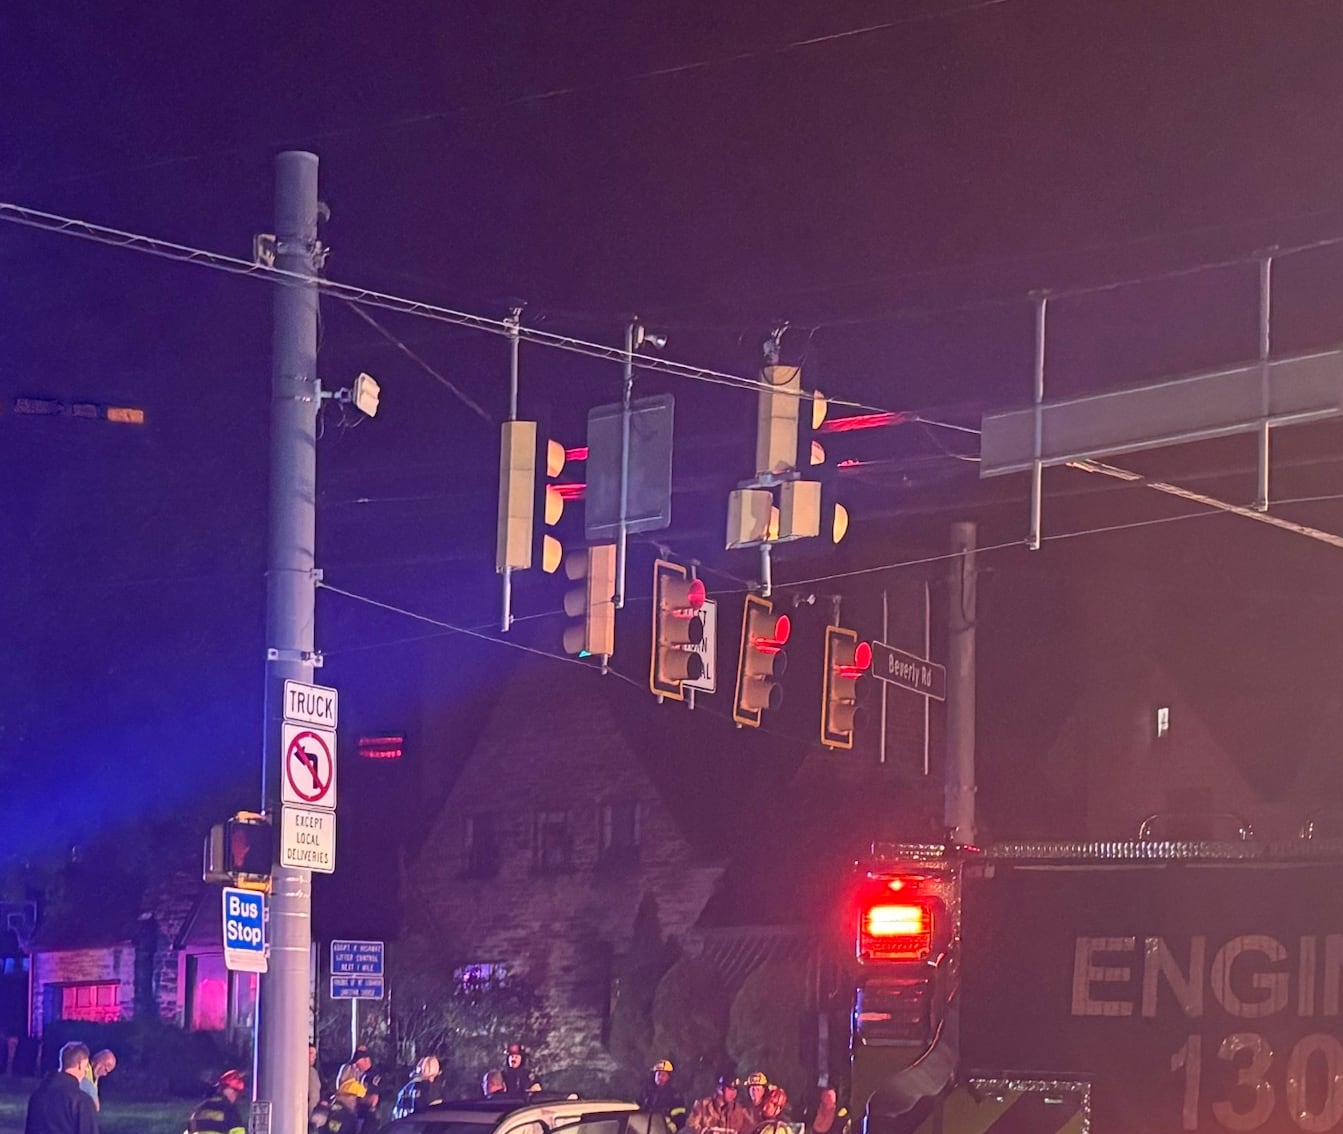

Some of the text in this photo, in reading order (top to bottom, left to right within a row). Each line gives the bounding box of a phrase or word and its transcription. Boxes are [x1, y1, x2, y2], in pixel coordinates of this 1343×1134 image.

[888, 654, 932, 687] Beverly Rd
[289, 690, 333, 719] TRUCK
[295, 814, 323, 830] EXCEPT
[296, 832, 320, 846] LOCAL
[287, 848, 329, 864] DELIVERIES
[229, 896, 258, 918] Bus
[227, 920, 261, 946] Stop
